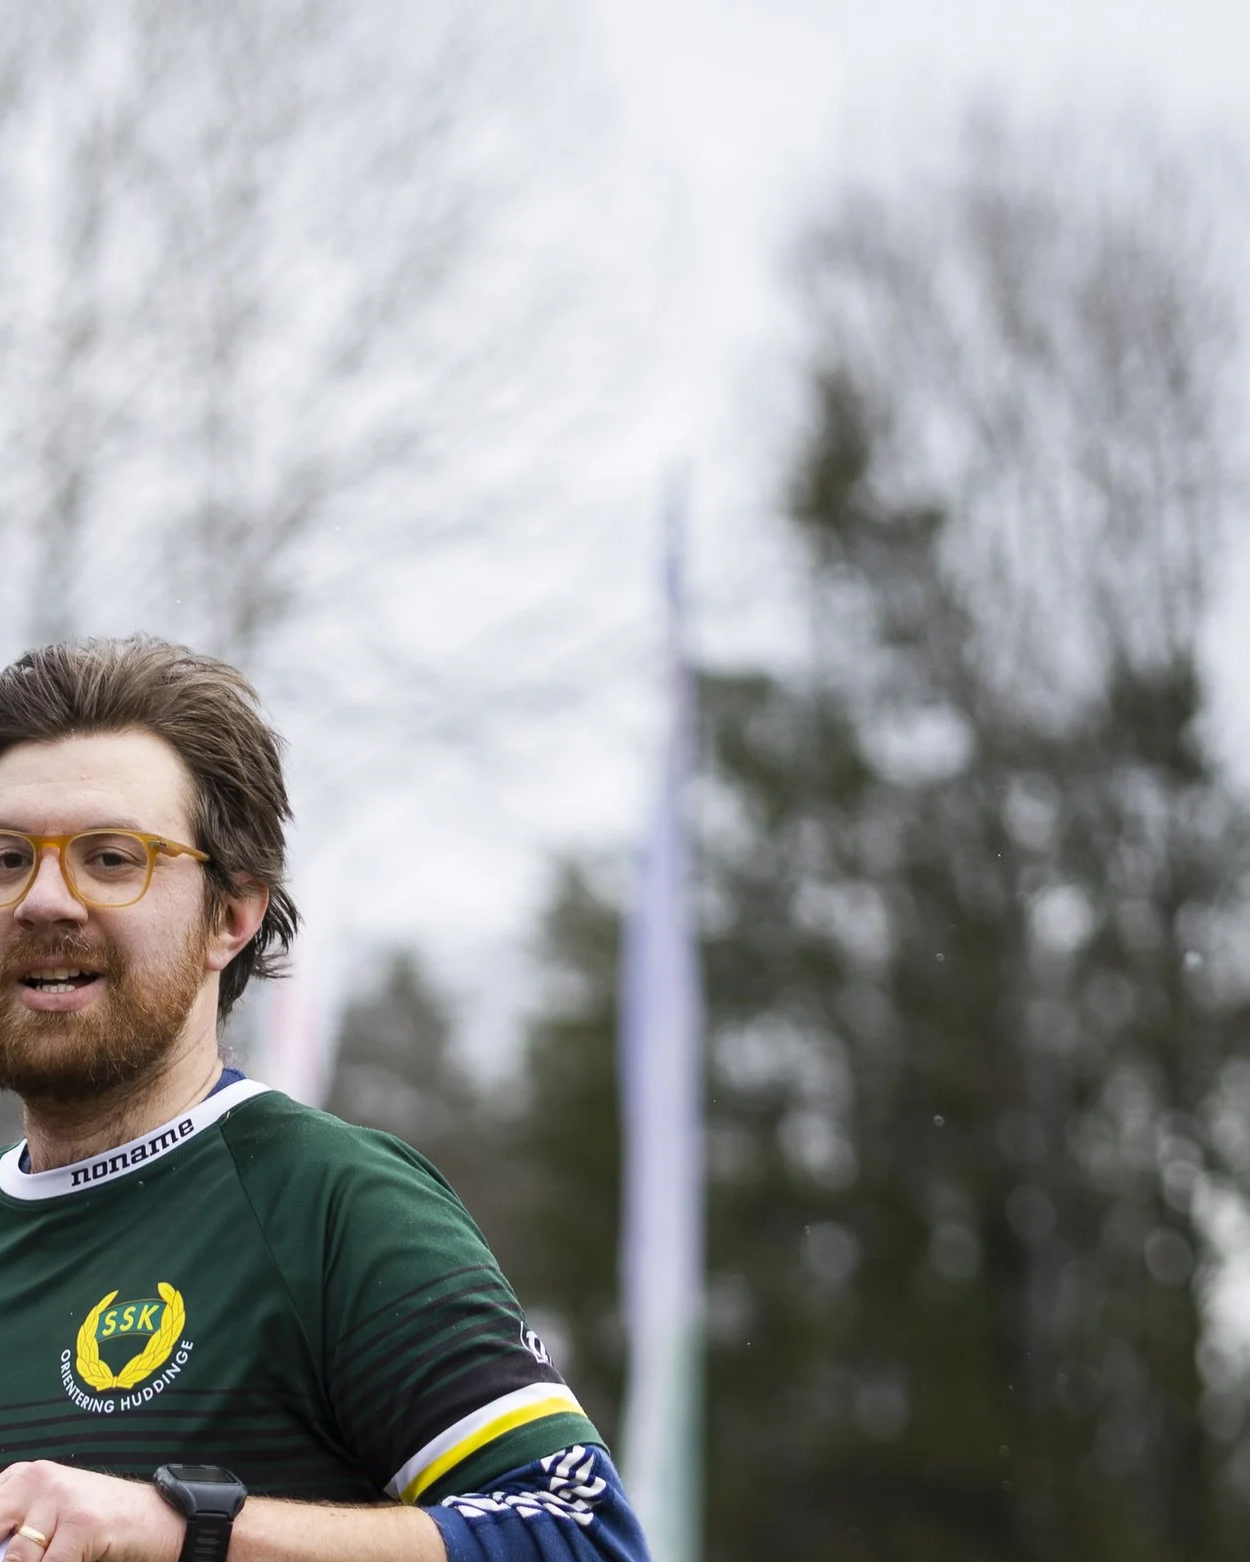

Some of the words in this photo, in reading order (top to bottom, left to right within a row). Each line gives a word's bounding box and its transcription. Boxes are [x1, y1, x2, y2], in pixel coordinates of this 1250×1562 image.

[71, 1118, 194, 1187] noname
[102, 1304, 159, 1336] SSK
[60, 1348, 115, 1414] ORIENTERING
[120, 1339, 193, 1412] HUDDINGE
